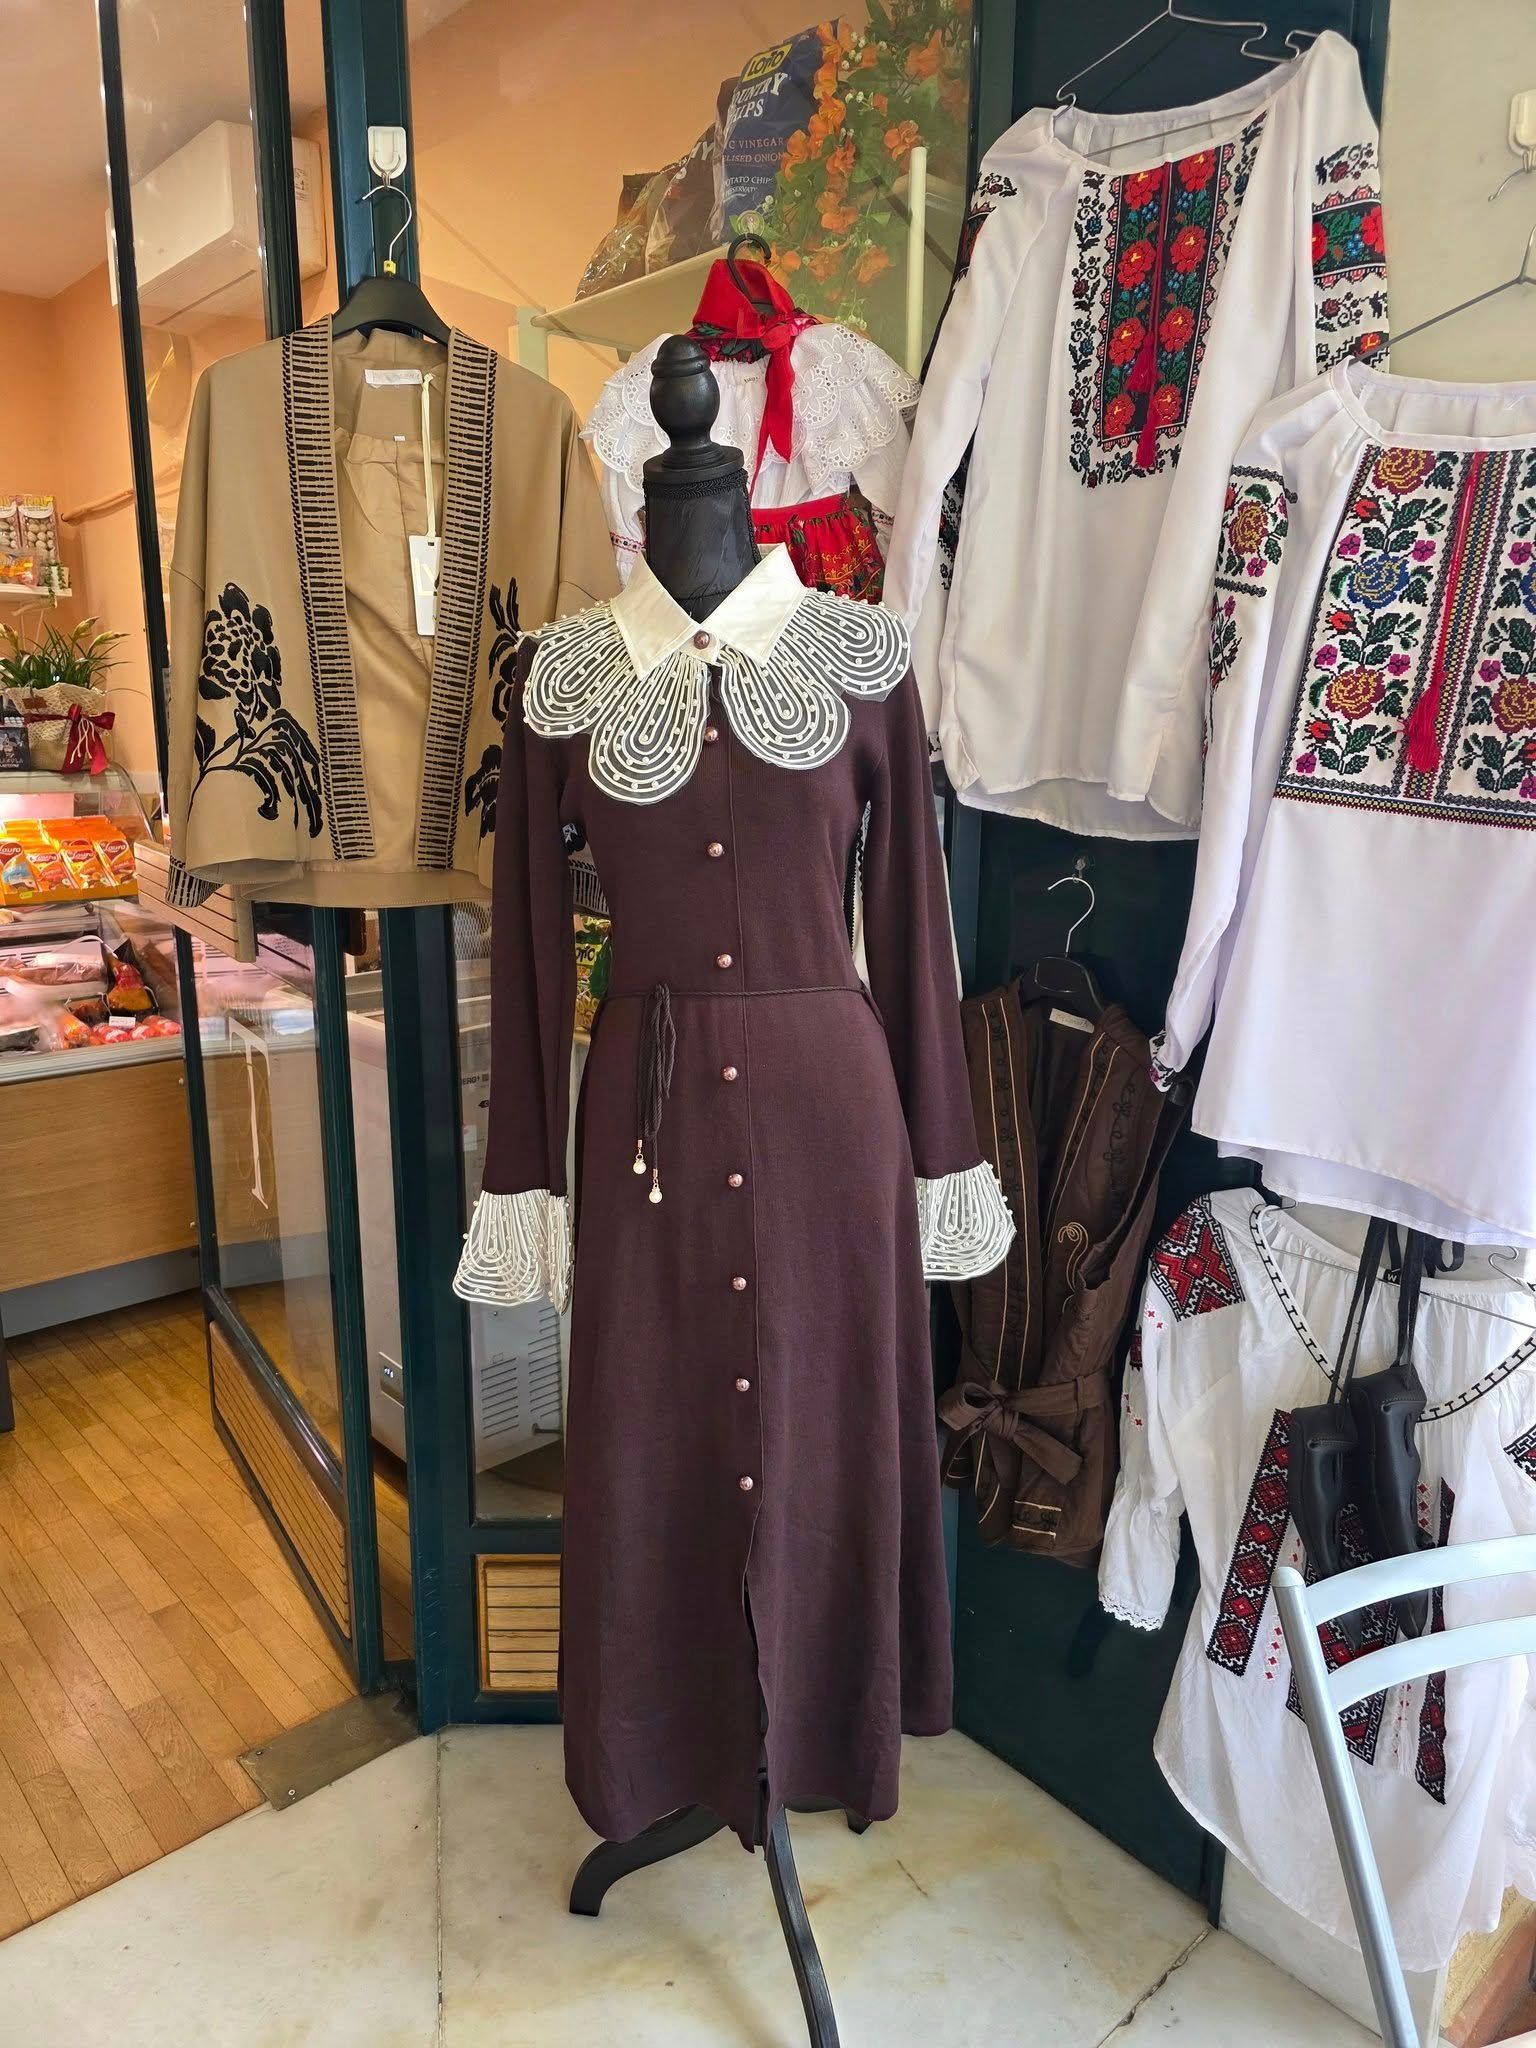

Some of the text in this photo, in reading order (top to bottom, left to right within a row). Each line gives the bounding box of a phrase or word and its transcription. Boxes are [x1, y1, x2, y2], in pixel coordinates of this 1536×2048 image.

[732, 72, 788, 104] OUNTRY
[731, 98, 764, 122] HIPS
[739, 137, 784, 149] VINEGAR
[725, 176, 749, 186] OTATO
